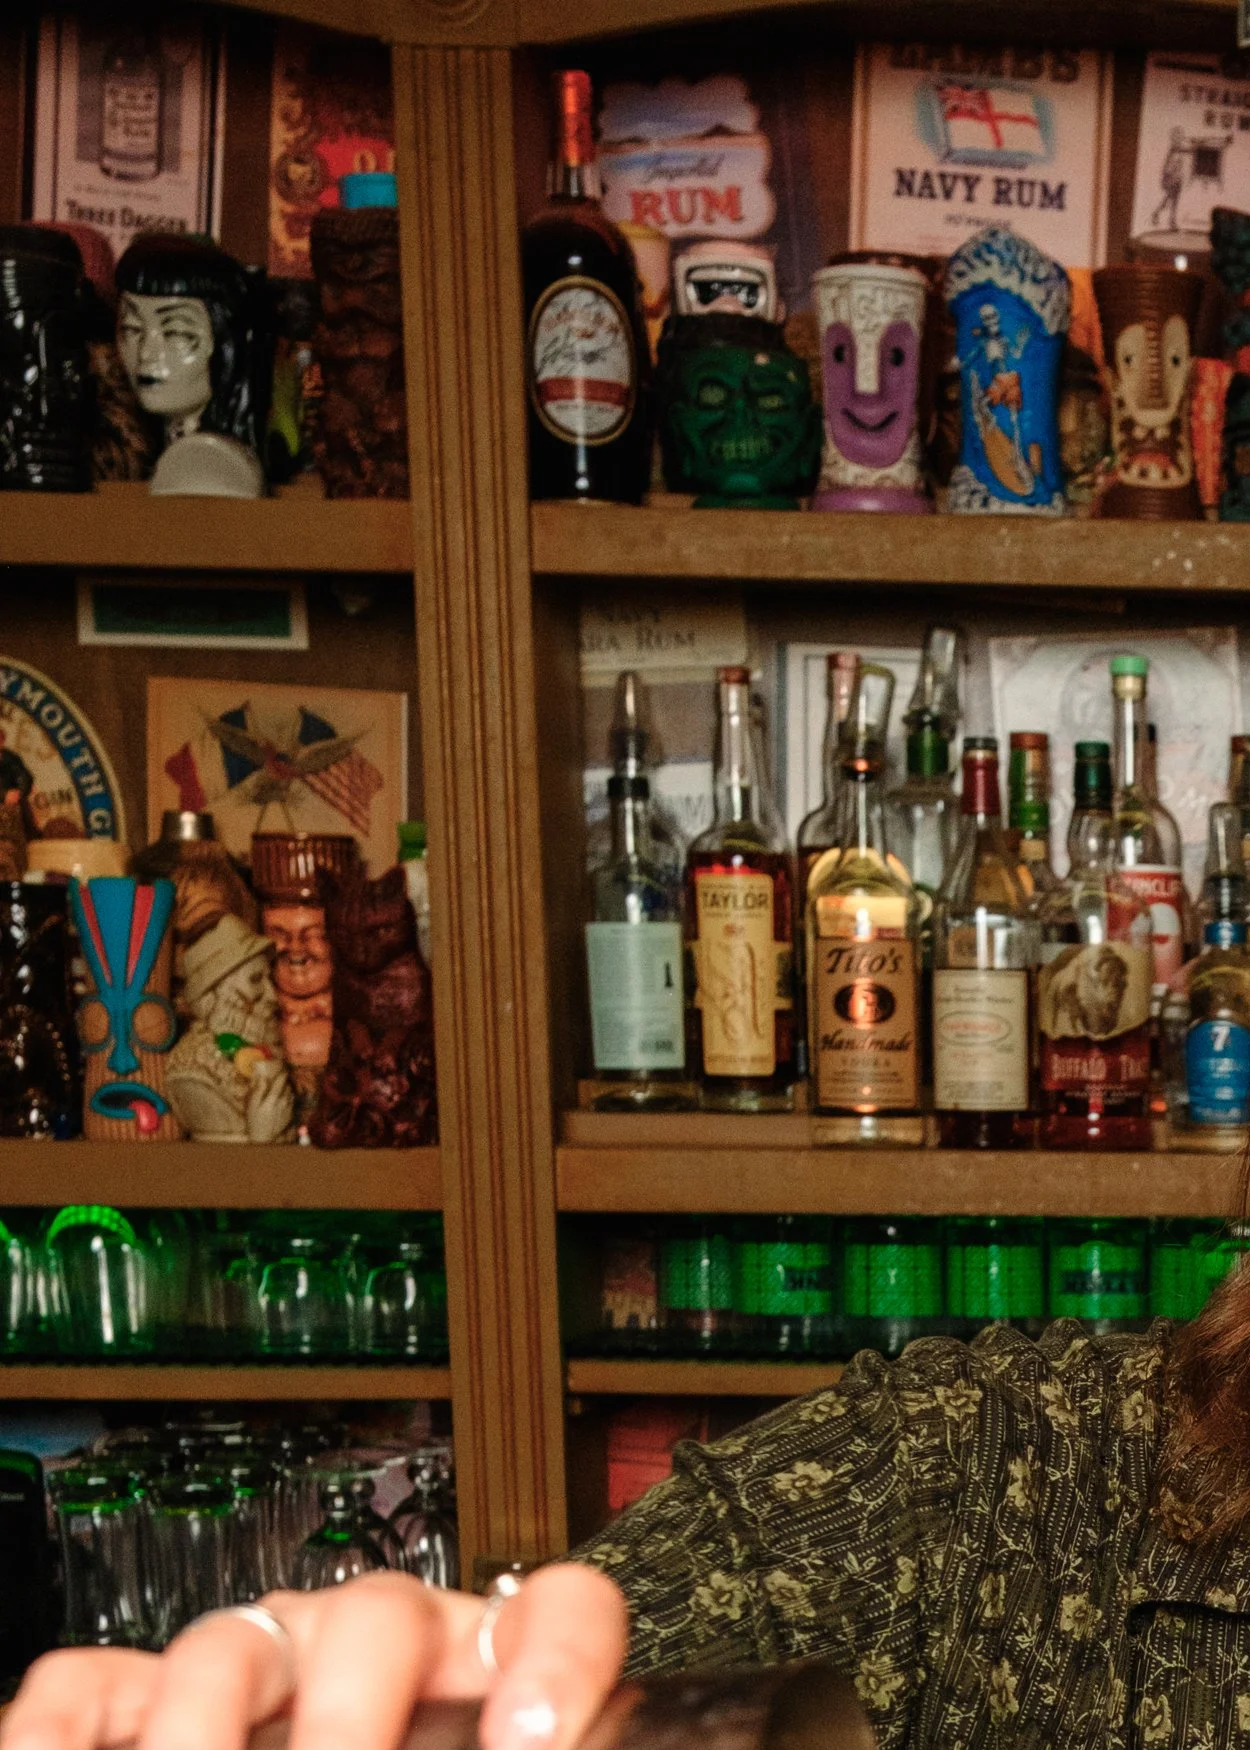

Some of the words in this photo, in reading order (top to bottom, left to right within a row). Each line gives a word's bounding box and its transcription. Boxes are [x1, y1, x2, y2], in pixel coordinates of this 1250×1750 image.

[894, 166, 981, 205] NAVY
[992, 175, 1067, 211] RUM
[630, 185, 745, 226] RUM
[702, 890, 770, 911] TAYLOR
[826, 945, 904, 976] Tito's
[821, 1027, 911, 1052] Handmade
[1210, 1026, 1231, 1053] 7
[1050, 1053, 1107, 1081] BUFFALO
